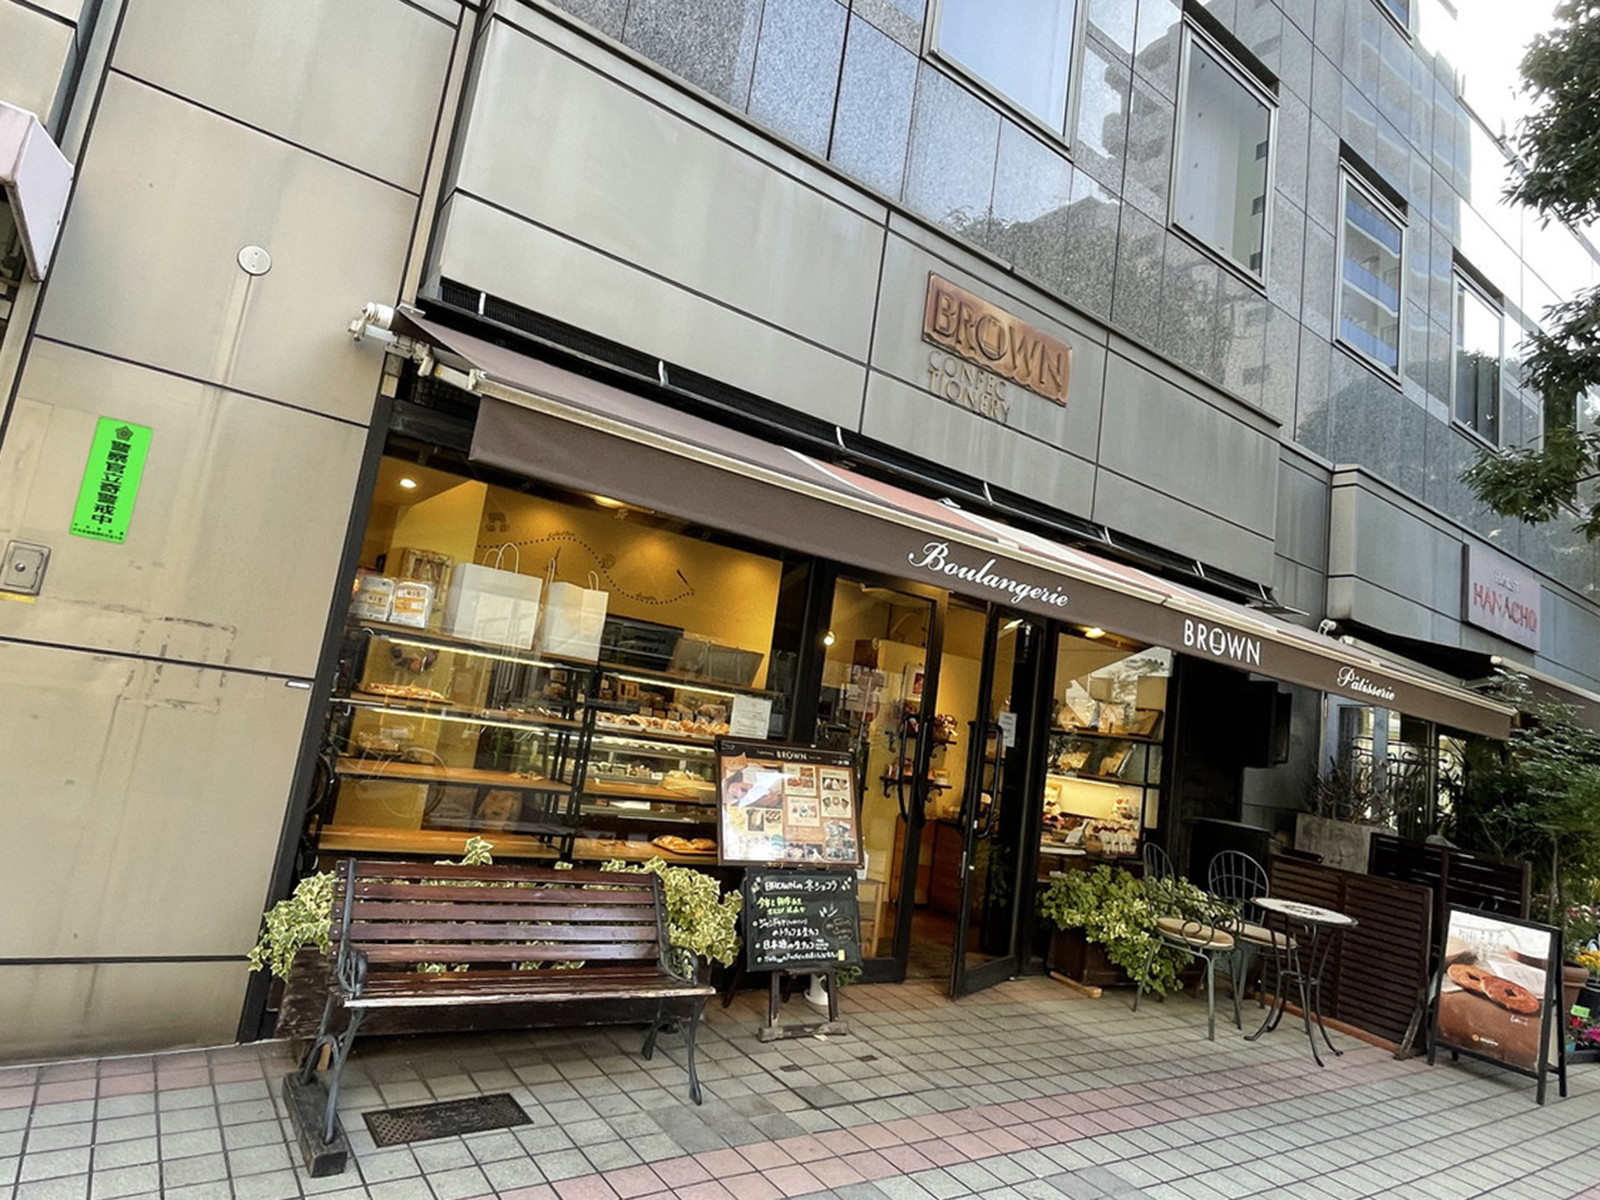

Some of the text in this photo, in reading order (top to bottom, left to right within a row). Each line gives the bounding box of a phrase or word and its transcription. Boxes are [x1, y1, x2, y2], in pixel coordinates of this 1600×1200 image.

[932, 289, 1063, 392] BROWN
[928, 368, 1010, 423] TIONERY
[929, 350, 1007, 401] CONFEC
[908, 542, 1069, 607] Boulangerie
[1183, 618, 1261, 666] BROWN
[1336, 666, 1396, 701] Pâtisserie
[776, 750, 807, 760] BROWN
